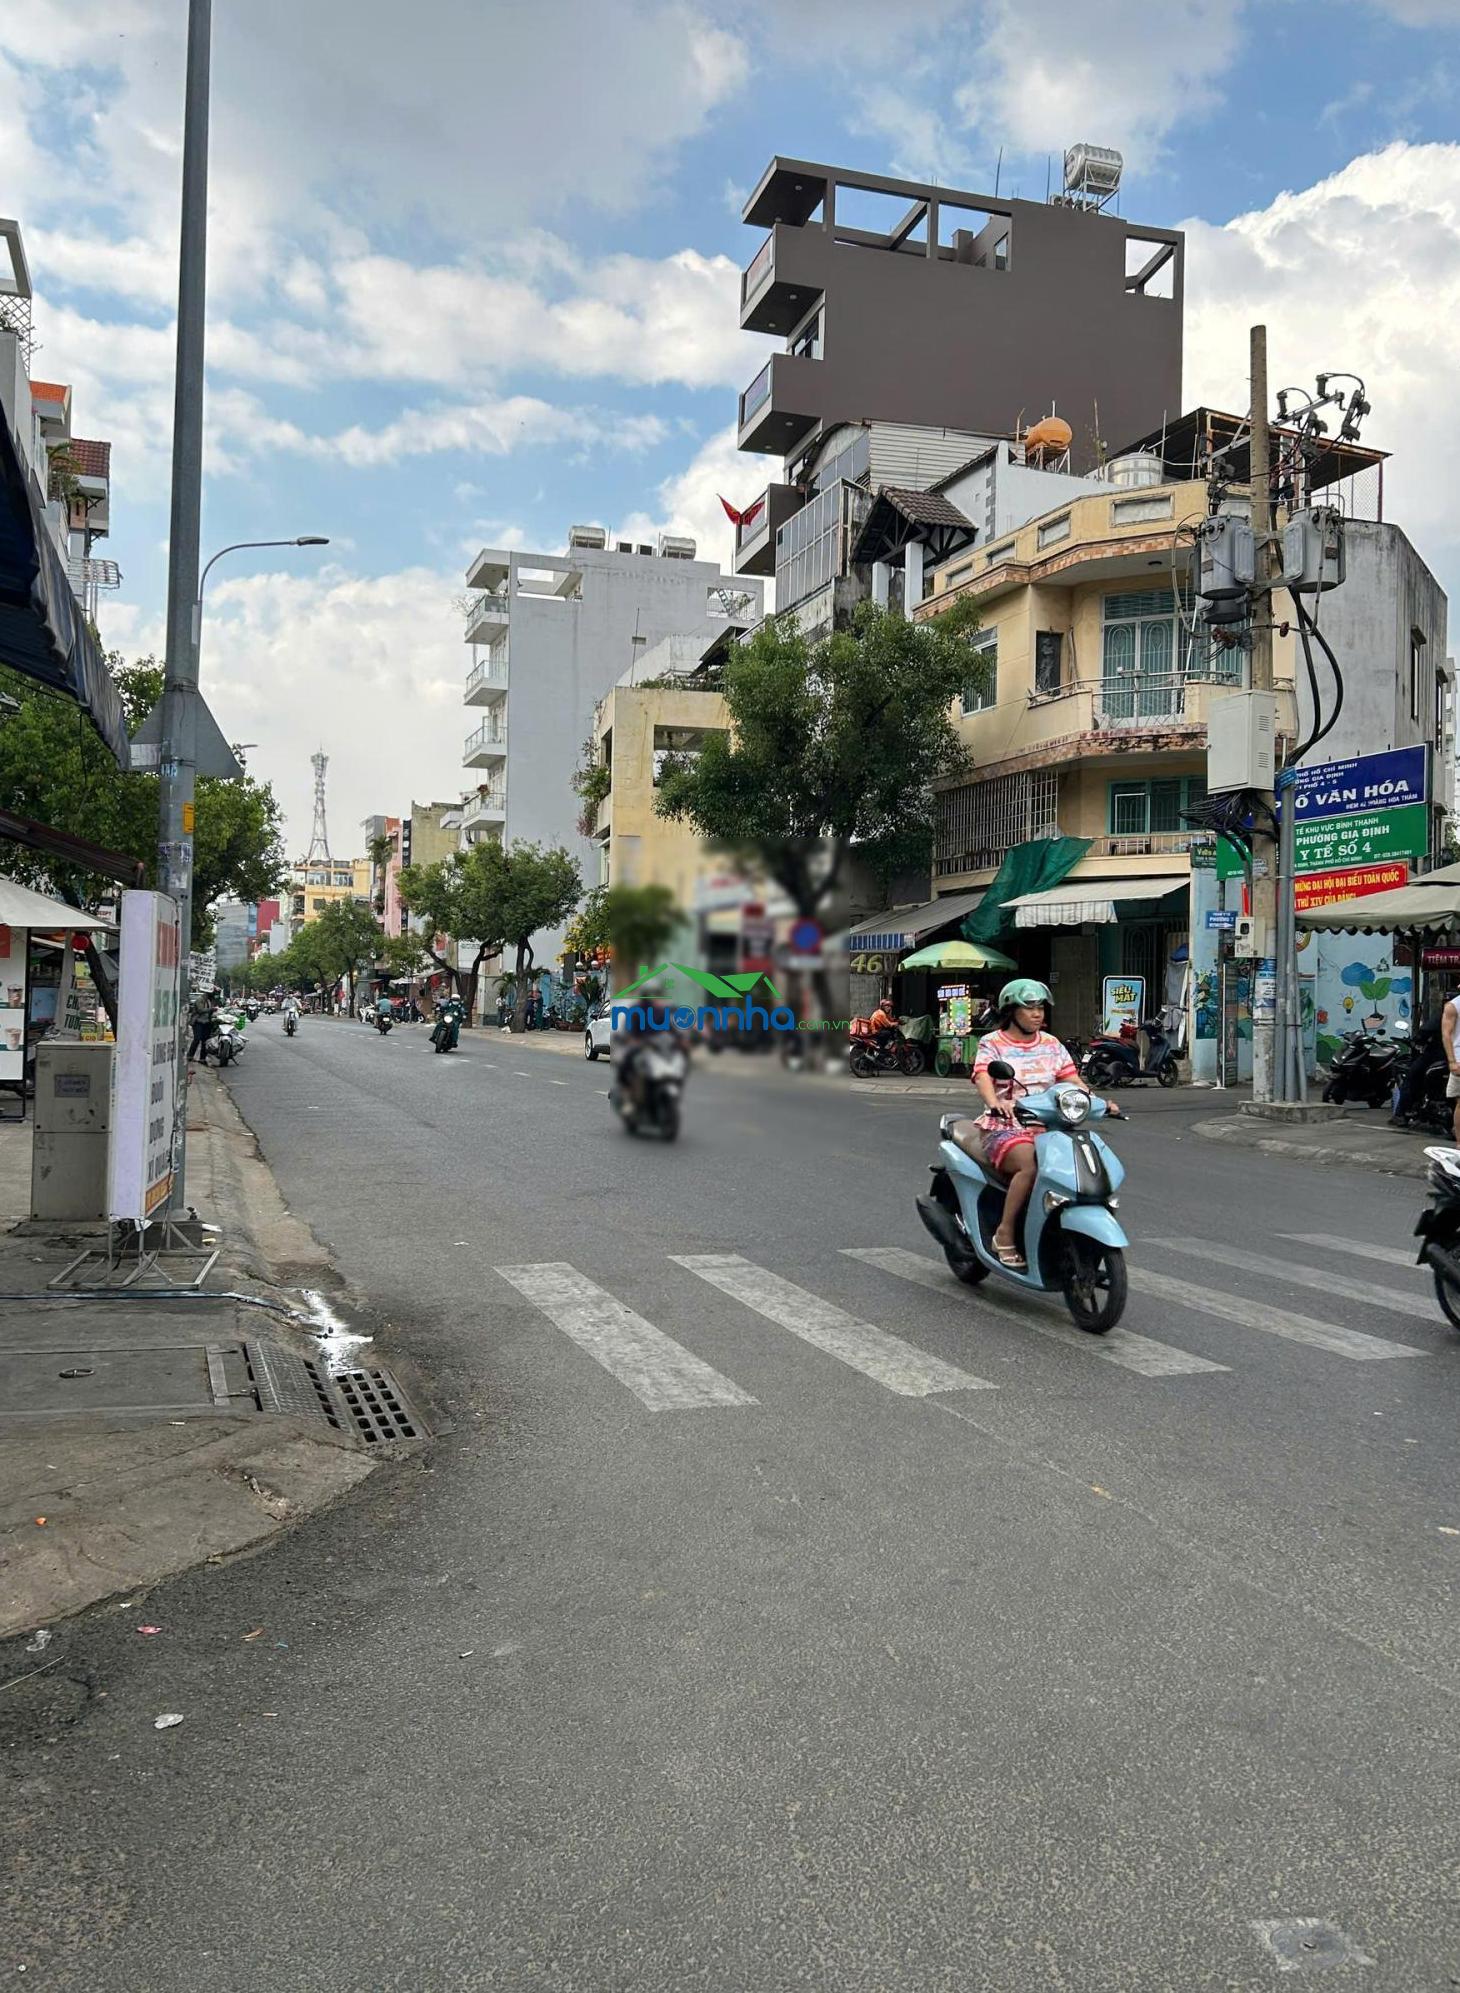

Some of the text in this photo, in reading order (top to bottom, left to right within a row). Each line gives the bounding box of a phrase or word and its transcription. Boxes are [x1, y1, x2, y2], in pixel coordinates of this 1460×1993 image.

[1315, 787, 1357, 806] VĂN
[1364, 779, 1410, 798] HÓA
[1296, 825, 1304, 835] TẾ
[1305, 826, 1320, 834] KHU
[1321, 823, 1335, 832] VỰC
[1296, 825, 1390, 846] PHƯỜNG GIA ĐỊNH
[1300, 838, 1372, 860] Y TẾ SỐ 4
[1312, 878, 1322, 891] ĐẠI
[1323, 876, 1334, 890] HỘI
[1335, 875, 1347, 888] ĐẠI
[1347, 870, 1361, 887] BIỂU
[1363, 871, 1380, 885] TOÀN
[1381, 868, 1400, 884] QUỐC
[1297, 895, 1310, 908] THỨ
[1310, 896, 1323, 907] XIV
[850, 953, 883, 974] 46
